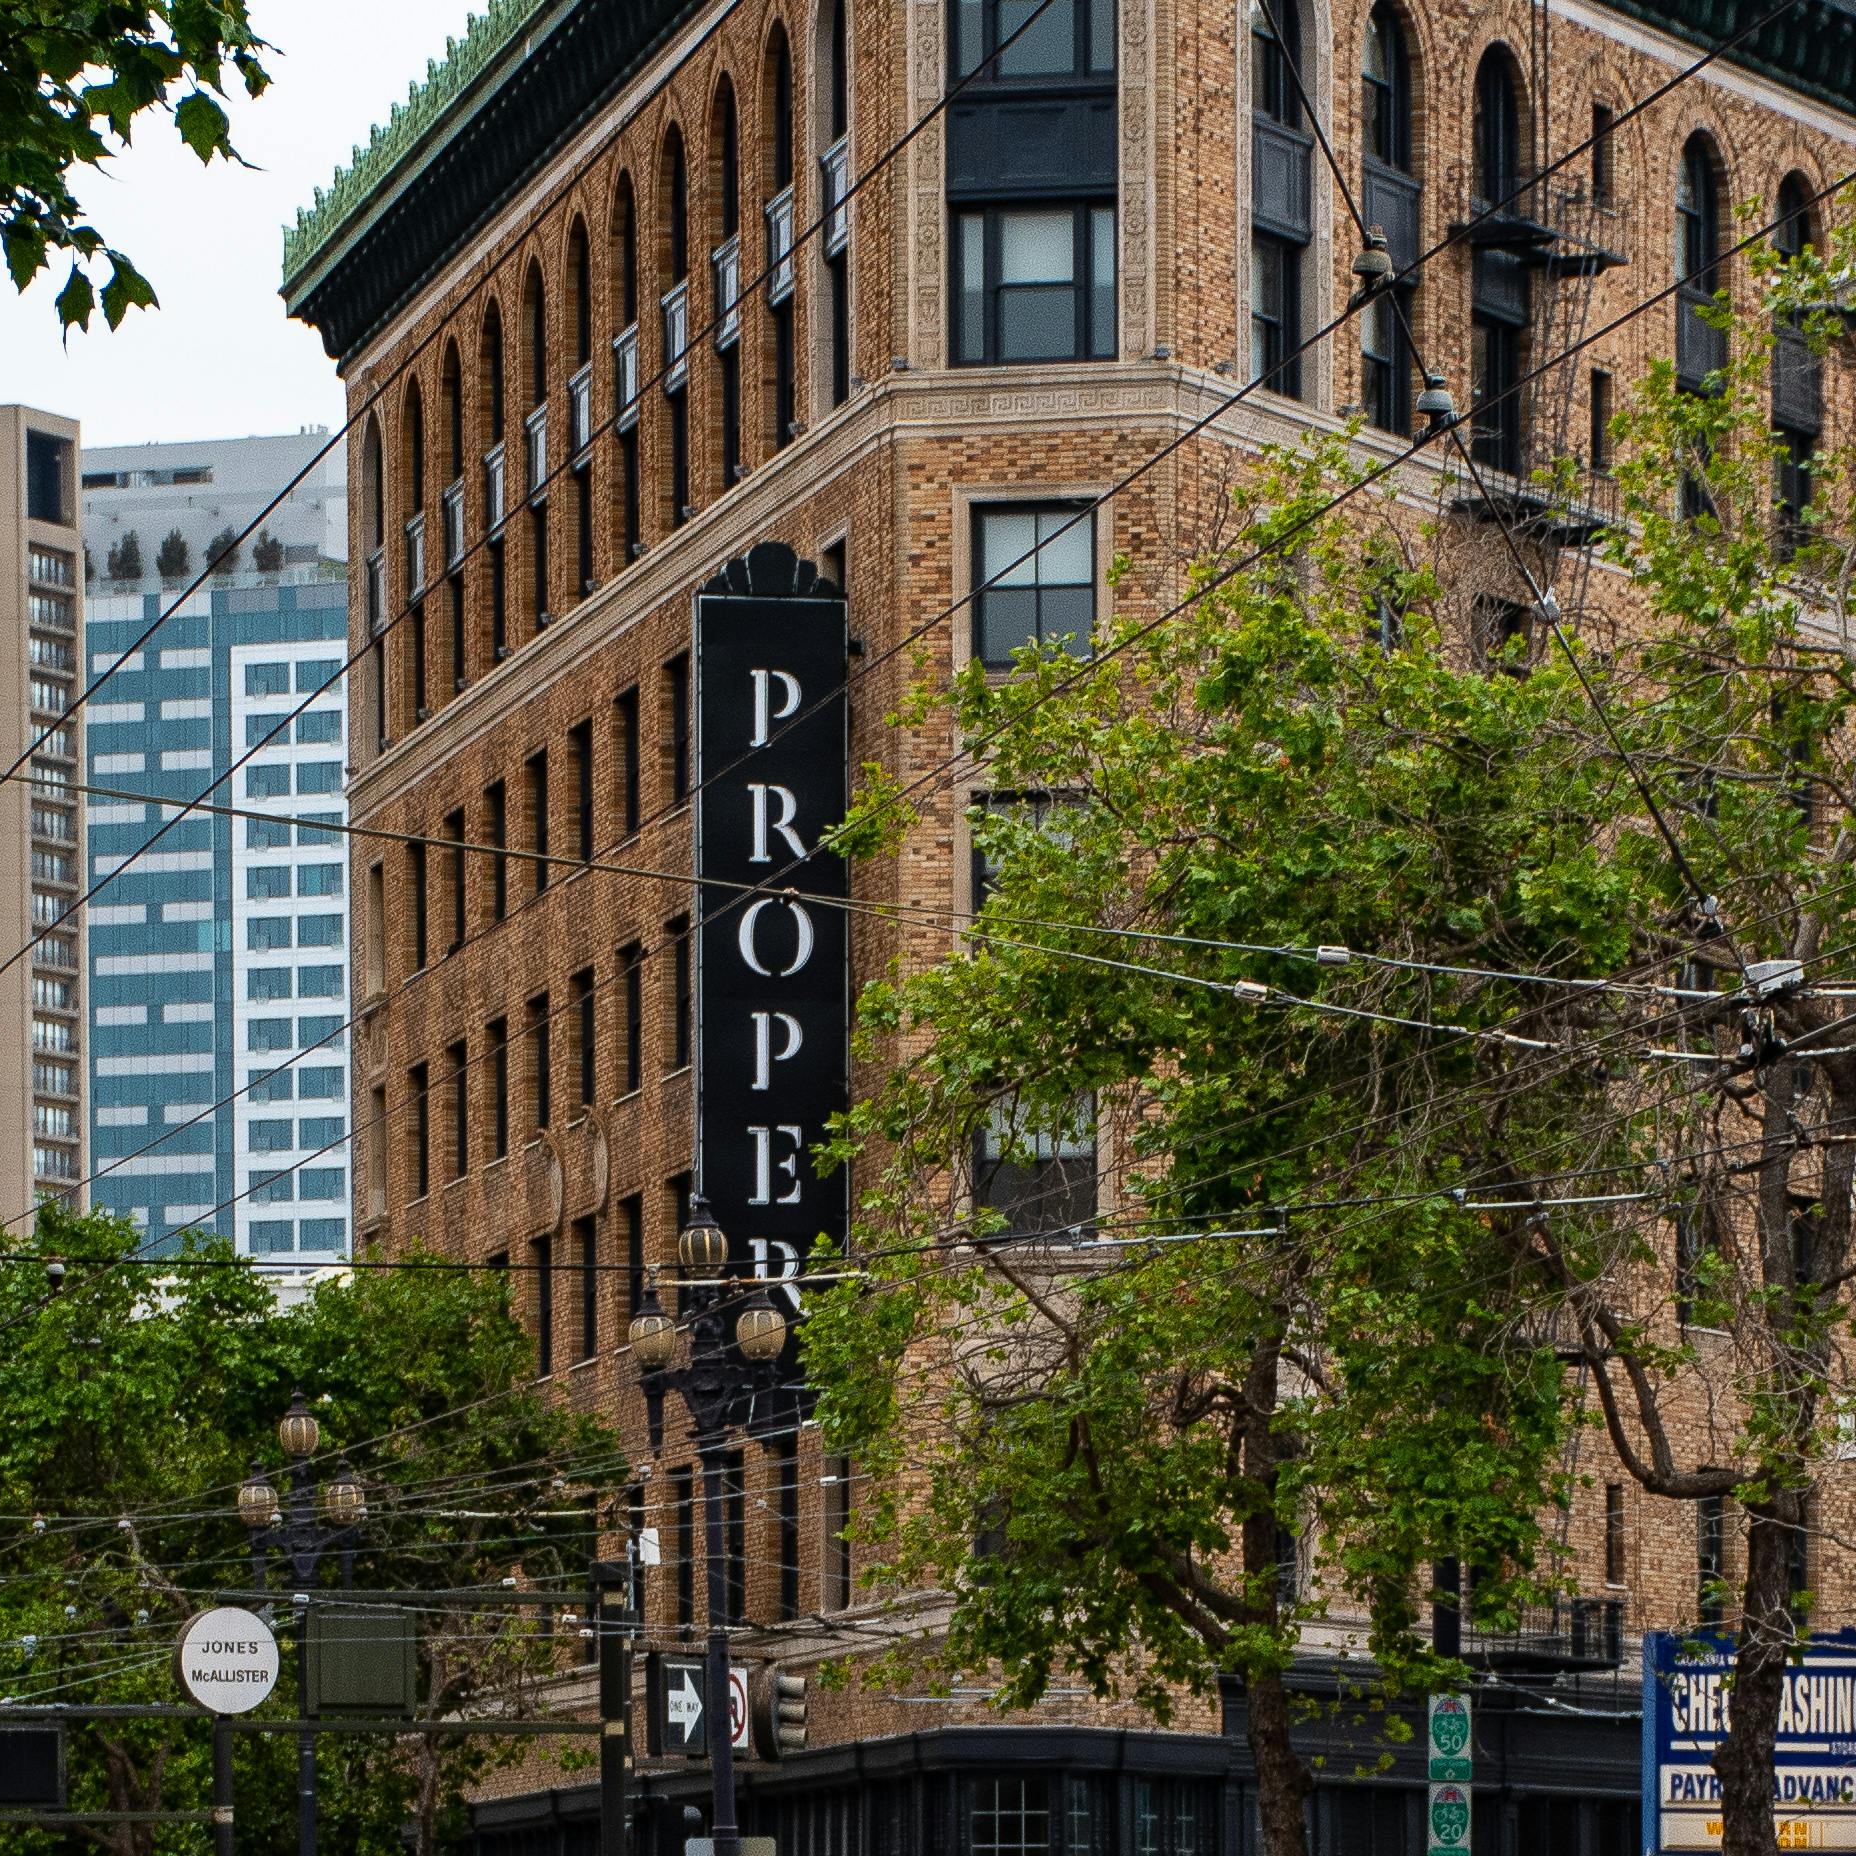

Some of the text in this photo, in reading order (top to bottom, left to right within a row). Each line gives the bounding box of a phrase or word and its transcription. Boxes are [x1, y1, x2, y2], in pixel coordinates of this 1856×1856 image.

[737, 668, 816, 1312] PROPER
[202, 1641, 259, 1654] JONES
[191, 1669, 269, 1683] McALLISTER
[669, 1701, 702, 1713] ONE WAY
[1671, 1673, 1734, 1733] CHEC
[1441, 1735, 1463, 1751] 50
[1441, 1824, 1463, 1840] 20
